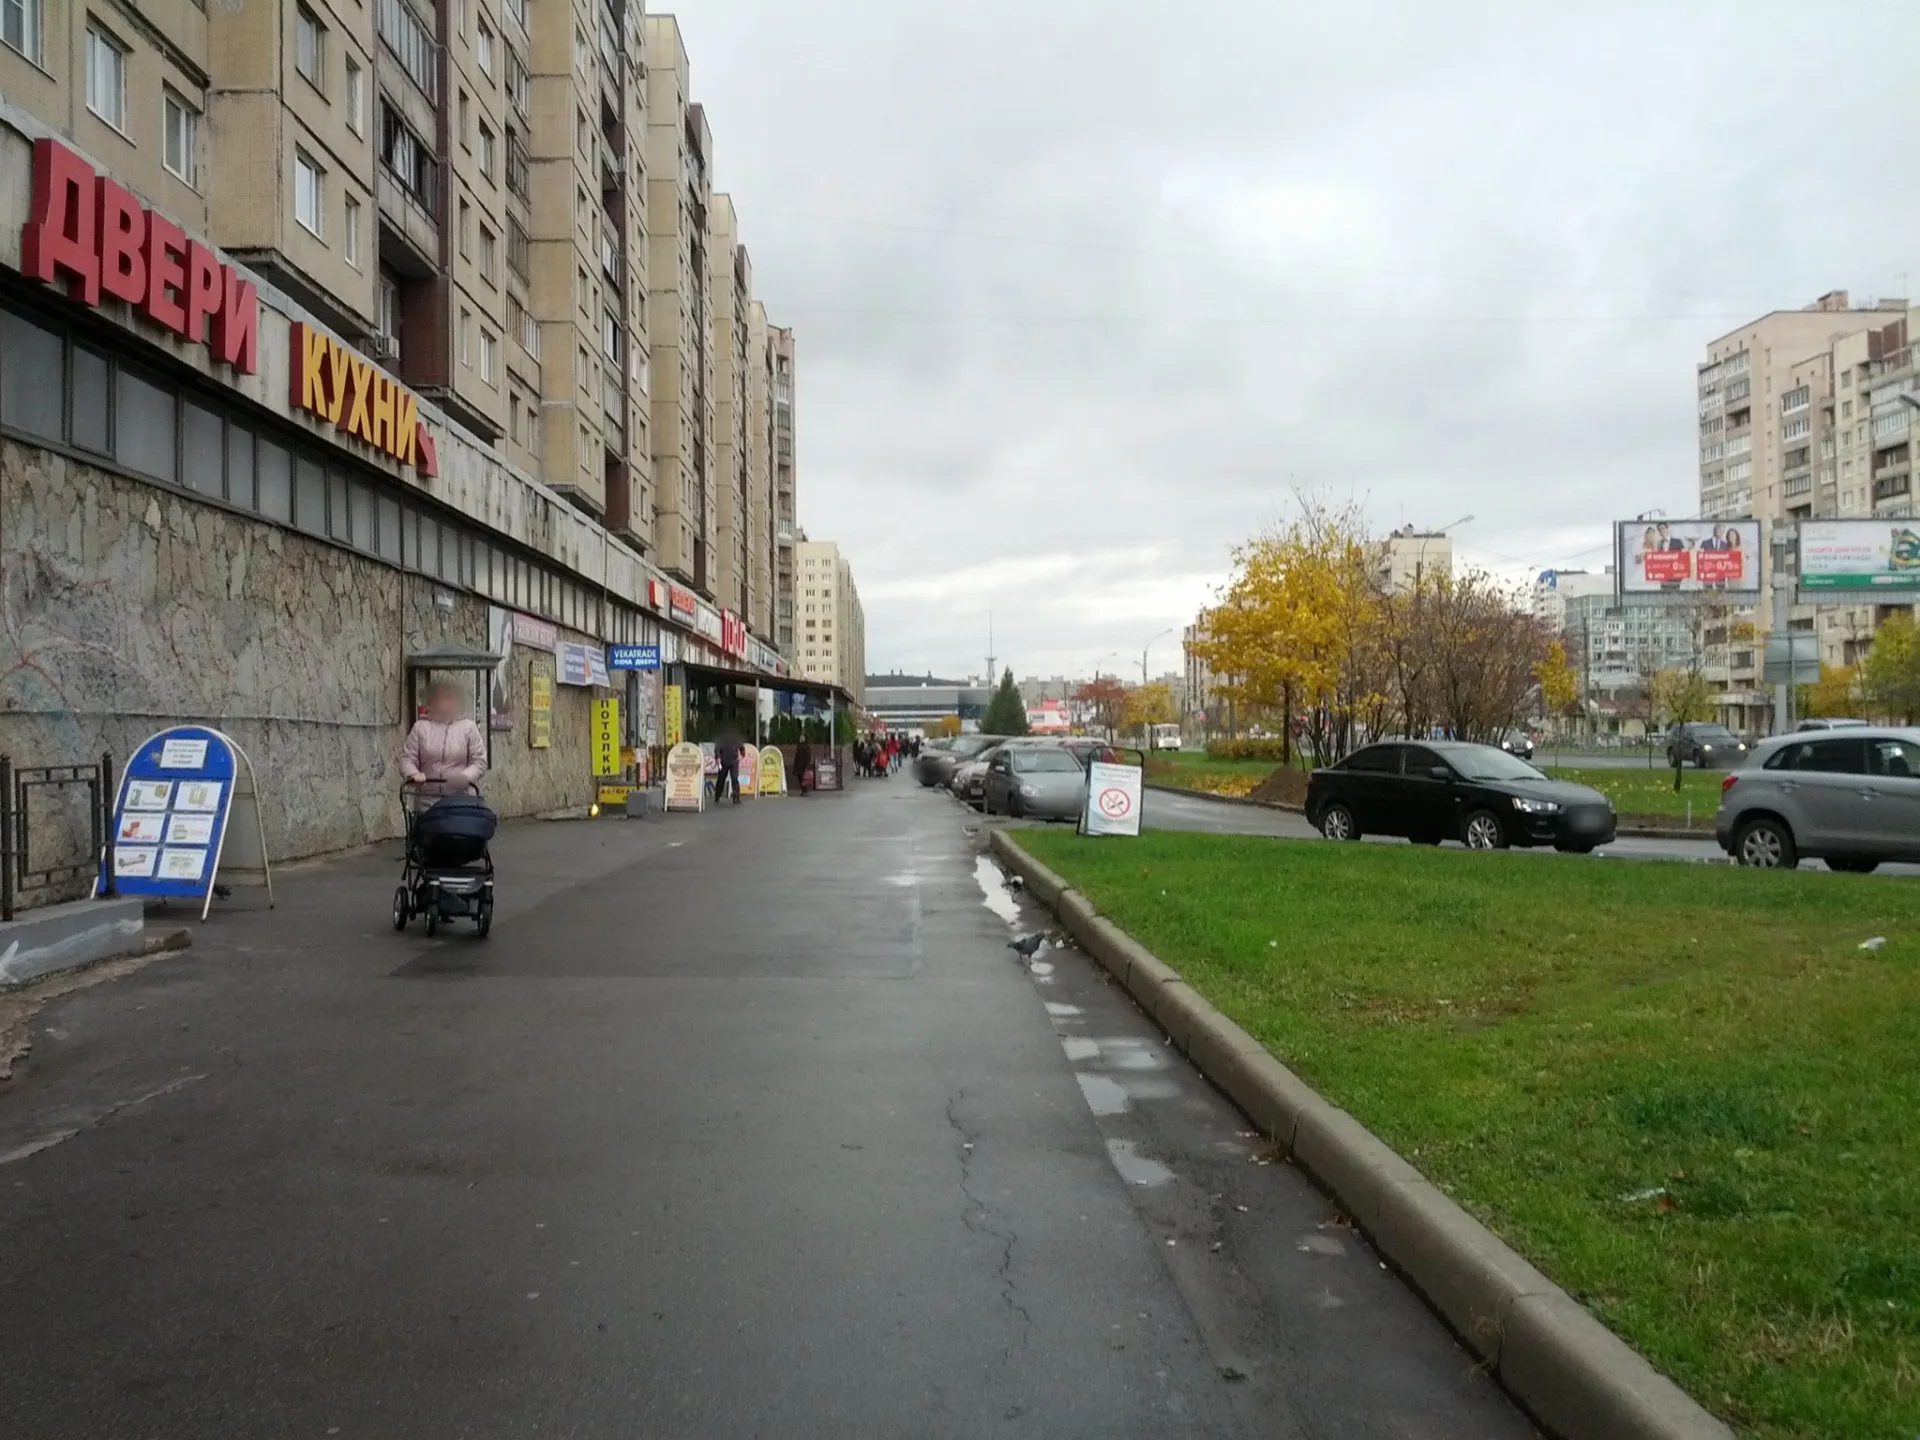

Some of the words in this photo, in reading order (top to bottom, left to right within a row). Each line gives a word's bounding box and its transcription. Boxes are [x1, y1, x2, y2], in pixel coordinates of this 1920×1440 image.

[23, 138, 257, 375] ДВЕРИ
[292, 321, 417, 465] КУХНИ
[614, 649, 656, 658] VEKATRADE
[600, 700, 611, 774] ПОТОЛКИ
